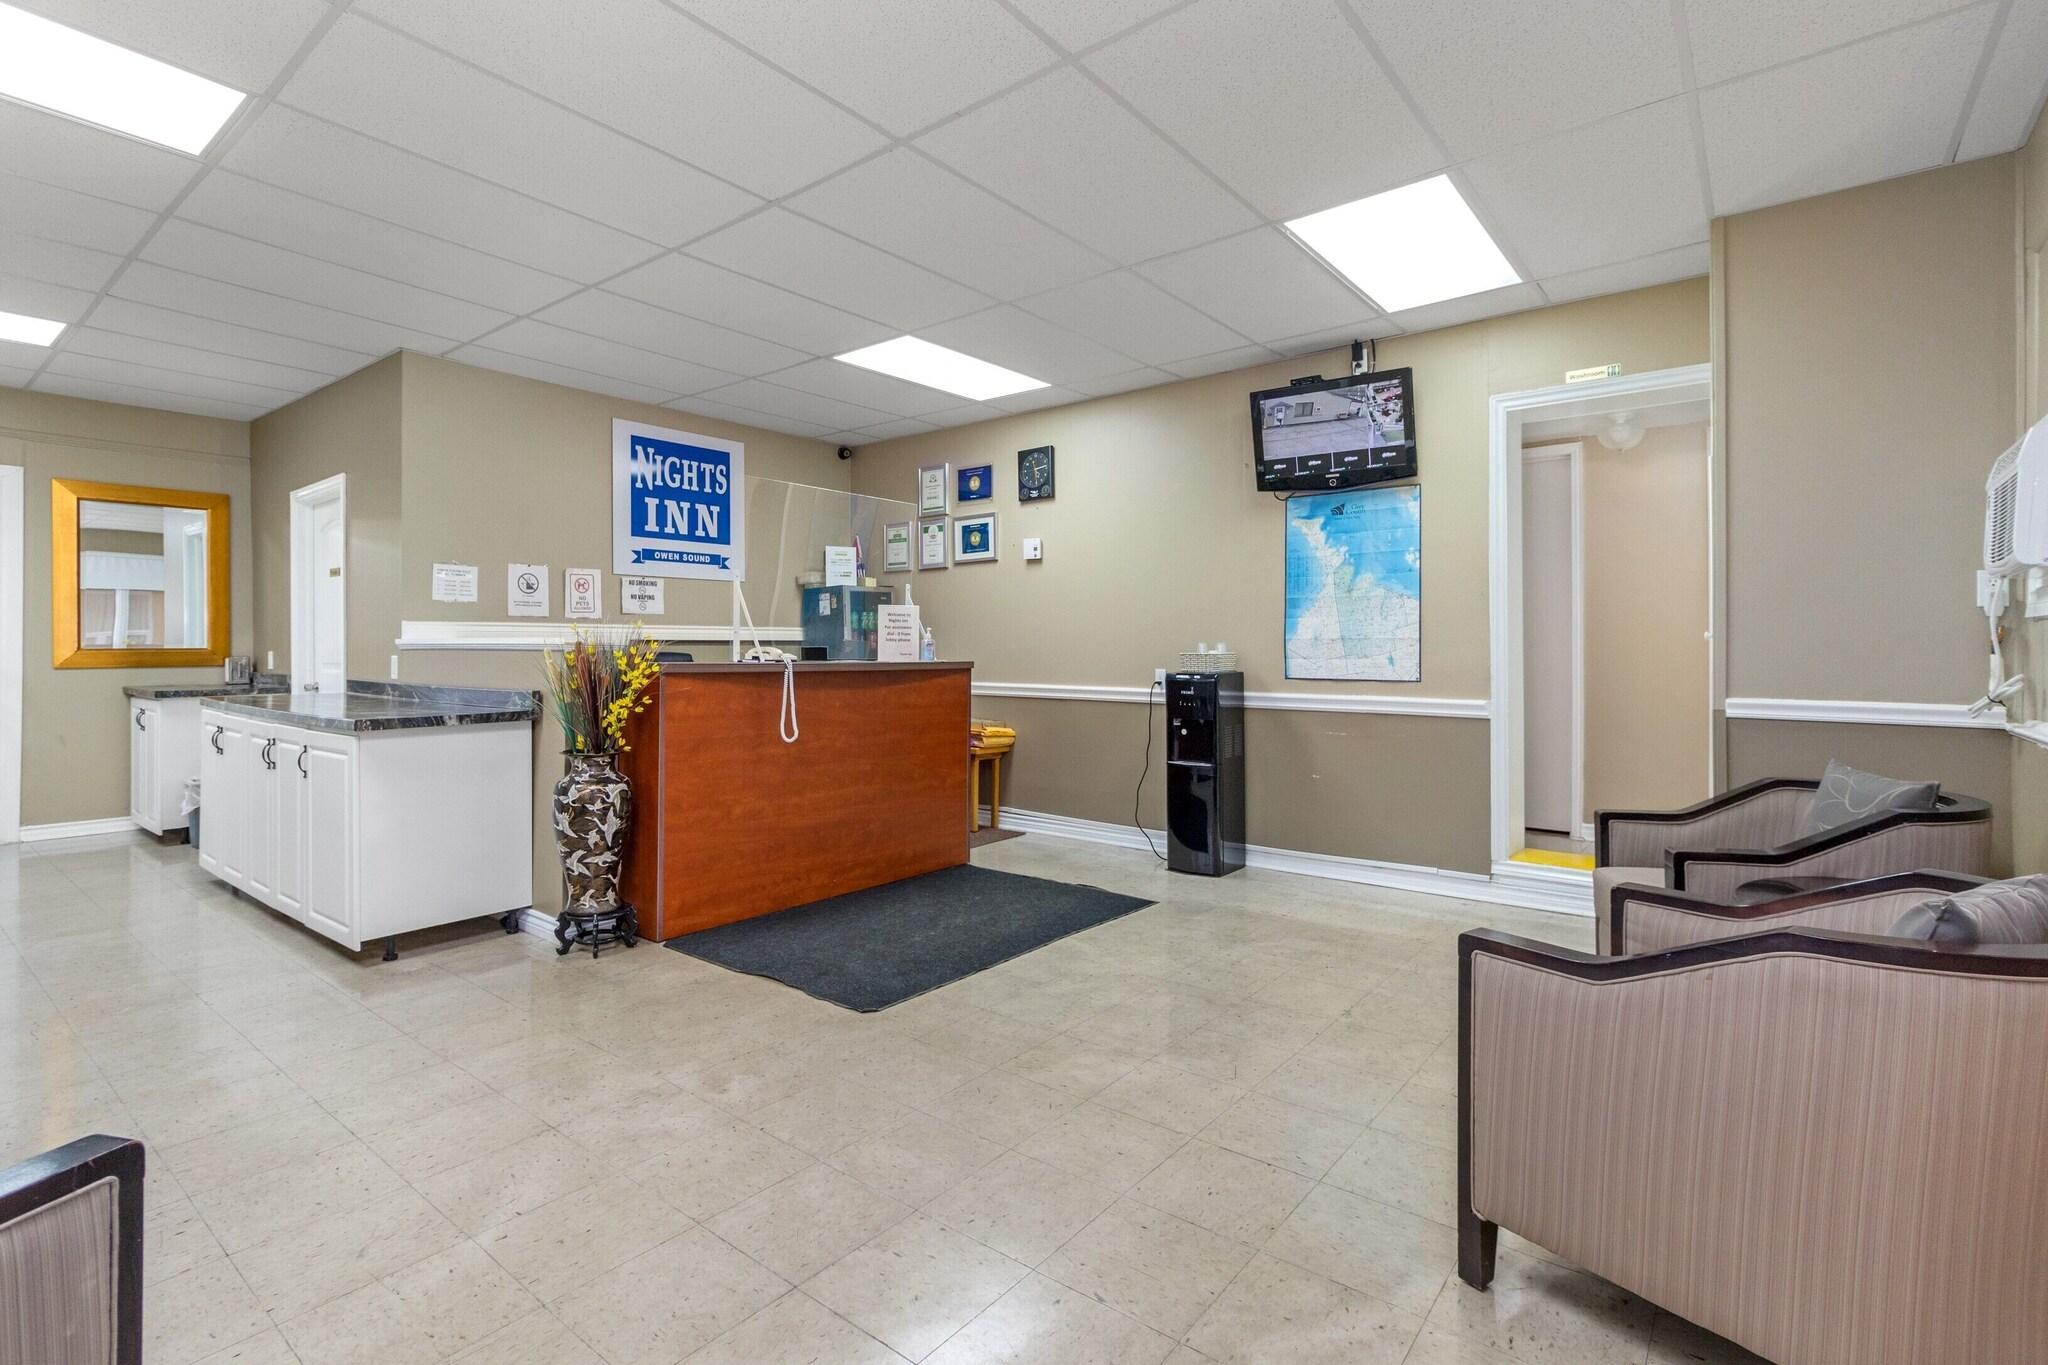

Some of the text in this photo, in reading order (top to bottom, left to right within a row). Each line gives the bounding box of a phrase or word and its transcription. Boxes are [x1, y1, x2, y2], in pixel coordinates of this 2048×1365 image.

[635, 445, 727, 495] NIGHTS
[644, 497, 720, 538] INN
[654, 551, 711, 563] OWEN SOUND
